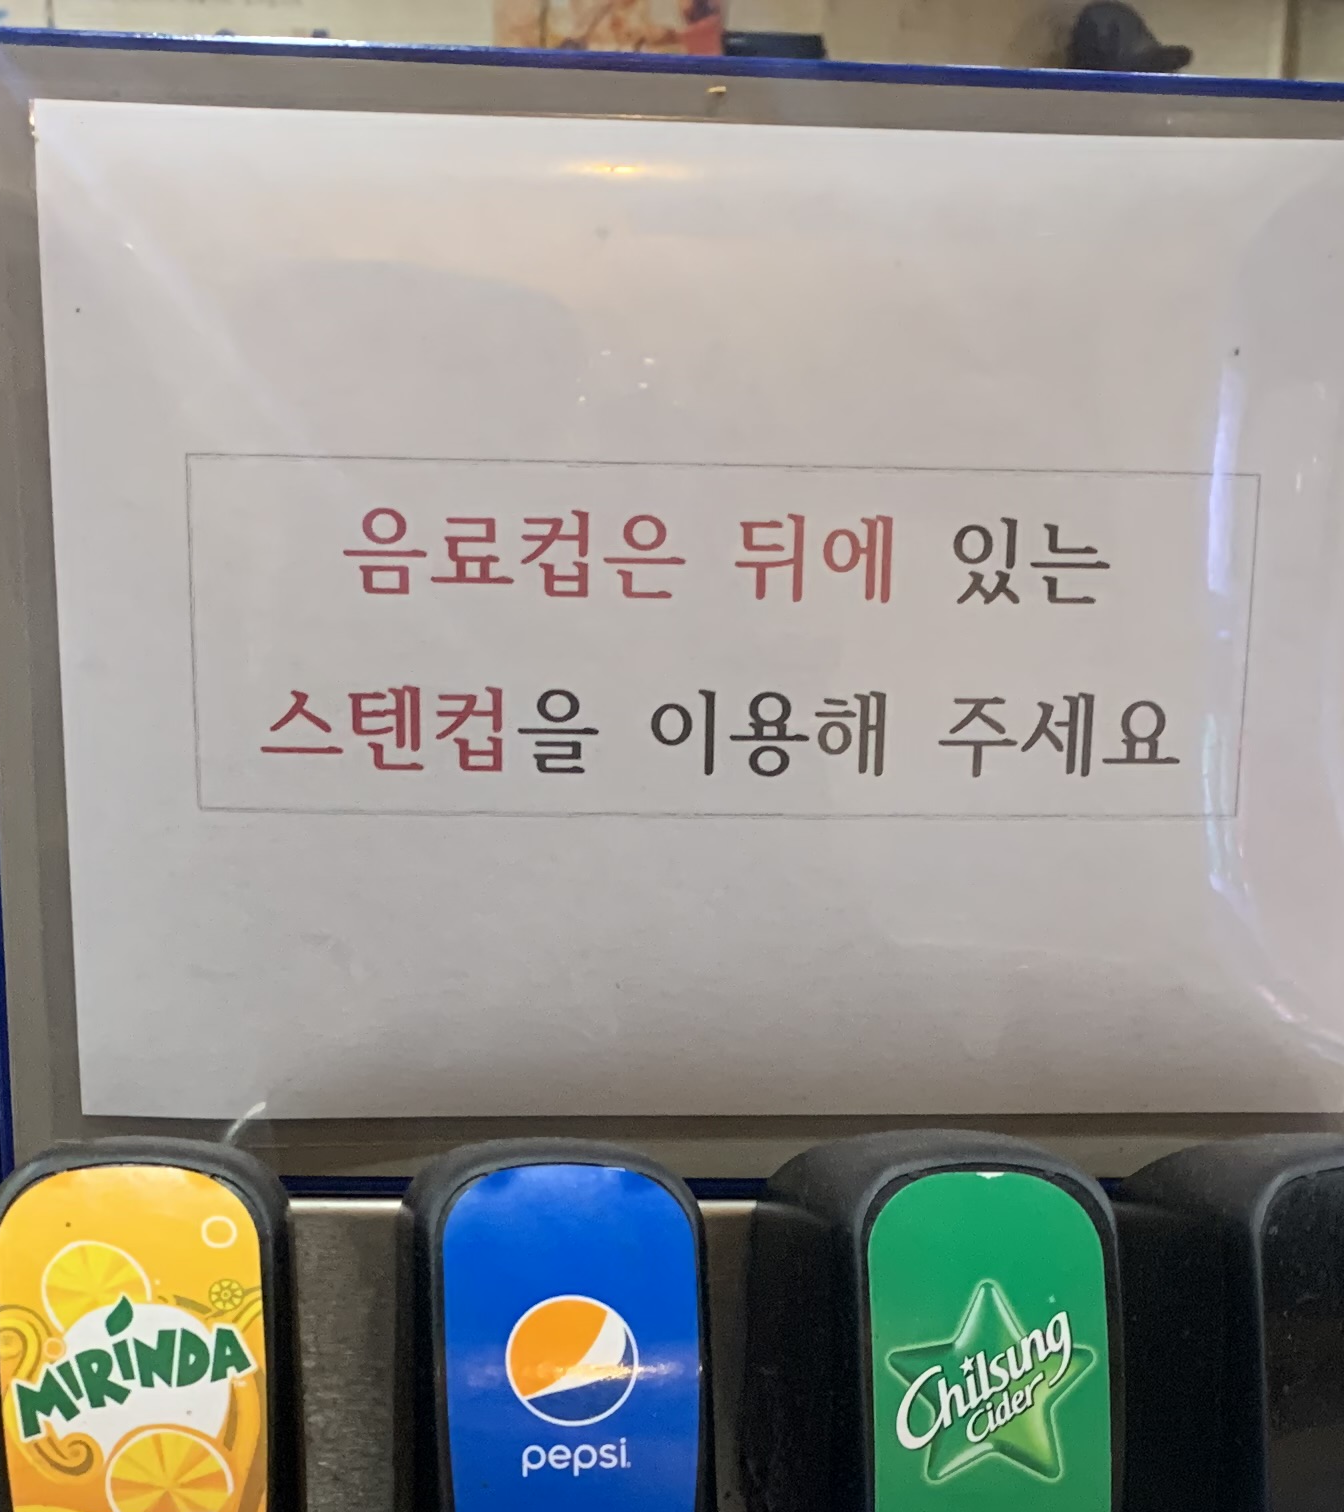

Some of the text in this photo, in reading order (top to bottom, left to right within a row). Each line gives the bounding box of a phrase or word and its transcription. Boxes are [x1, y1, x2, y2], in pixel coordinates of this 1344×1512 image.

[343, 507, 1110, 604] 음료컵은 뒤에 있는
[260, 685, 1180, 777] 스텐컵을 이용해 주세요
[14, 1296, 253, 1438] MIRINDA
[895, 1311, 1073, 1450] Chilsung
[966, 1372, 1044, 1443] Cider
[522, 1437, 632, 1478] pepsi
